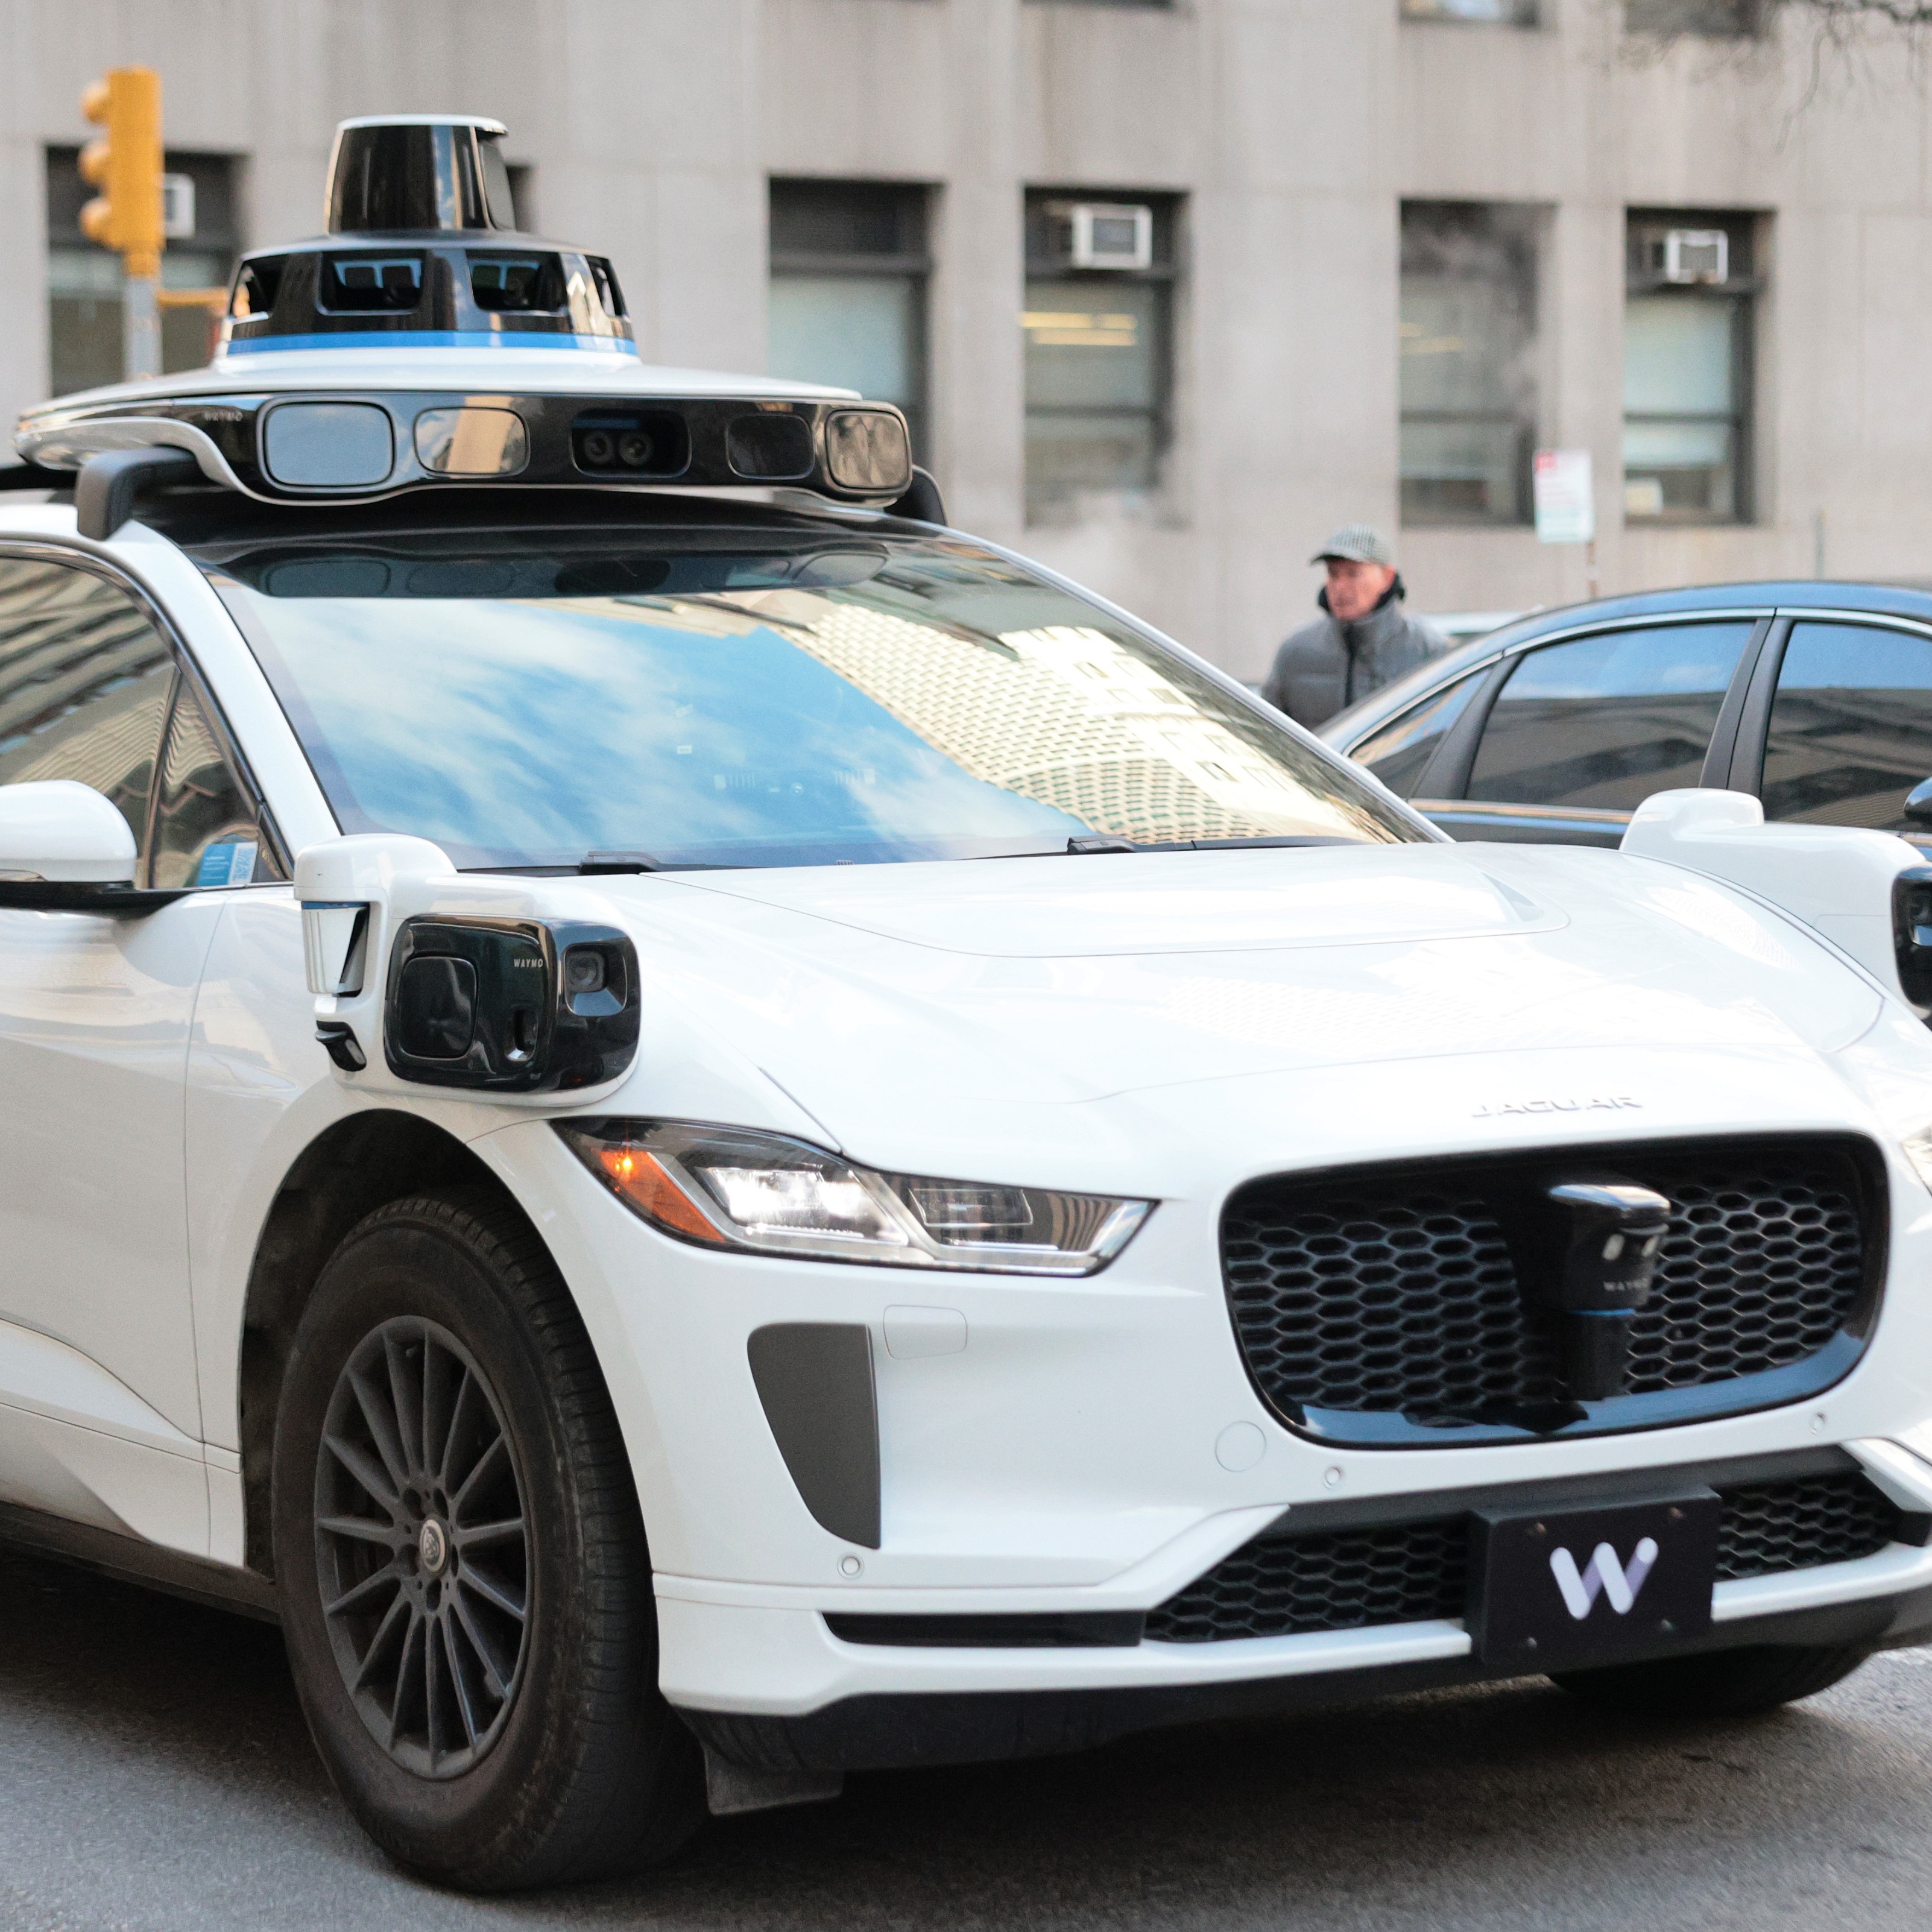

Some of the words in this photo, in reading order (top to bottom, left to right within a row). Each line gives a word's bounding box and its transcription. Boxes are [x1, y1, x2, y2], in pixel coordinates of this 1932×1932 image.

[514, 958, 543, 968] WAYMO
[1472, 1097, 1643, 1117] JAGUAR
[1550, 1536, 1659, 1621] W
